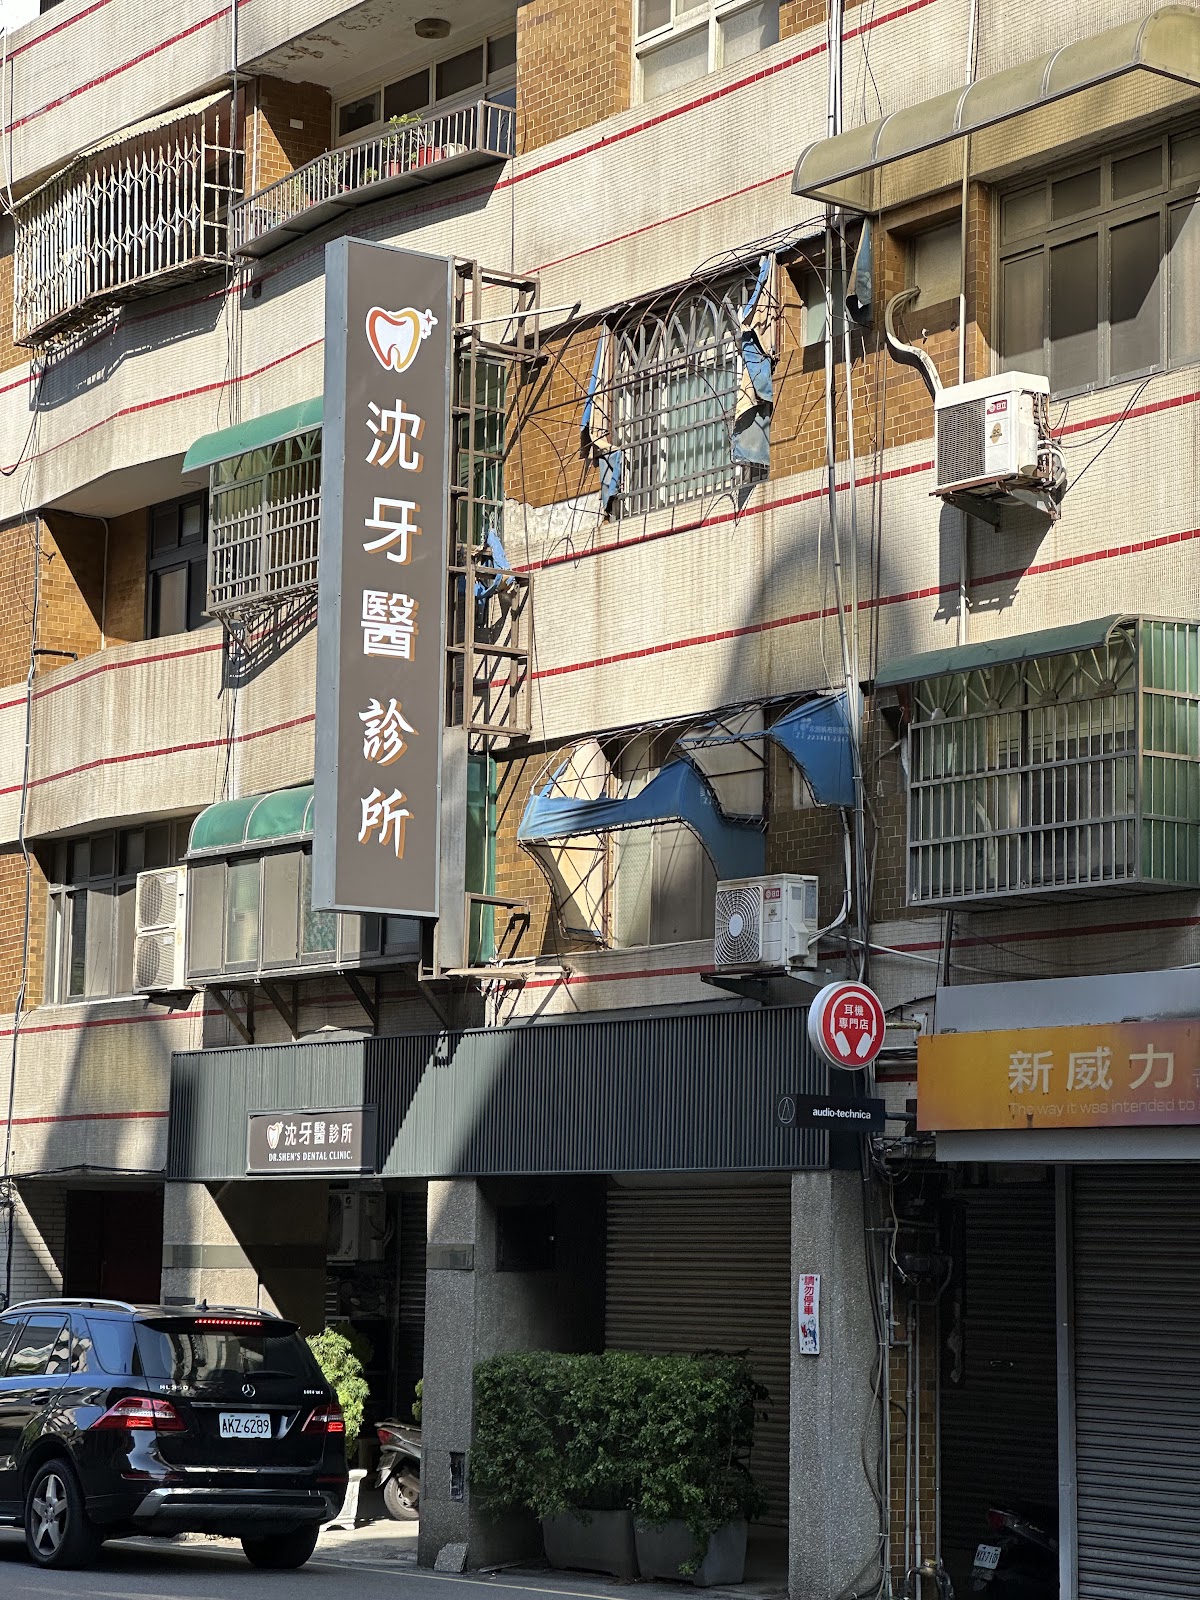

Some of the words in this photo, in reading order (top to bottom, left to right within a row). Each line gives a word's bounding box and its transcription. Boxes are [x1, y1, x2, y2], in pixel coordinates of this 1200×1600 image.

[357, 398, 421, 858] 沈牙醫診所
[844, 1004, 864, 1016] 耳機
[839, 1017, 869, 1030] 專門店
[1008, 1044, 1175, 1094] 新威力
[812, 1107, 872, 1120] audio-technica
[1010, 1102, 1033, 1116] The
[1037, 1103, 1064, 1117] way
[1067, 1103, 1077, 1114] it
[1080, 1104, 1108, 1114] was
[1111, 1099, 1174, 1113] intended
[1179, 1099, 1195, 1112] to
[284, 1121, 353, 1146] 沈牙醫診所
[268, 1152, 301, 1162] DR.SHEN'S
[303, 1151, 328, 1161] DENTAL
[329, 1150, 353, 1160] CLINIC.
[803, 1275, 815, 1315] 請勿停車
[222, 1418, 270, 1434] AKZ-6289
